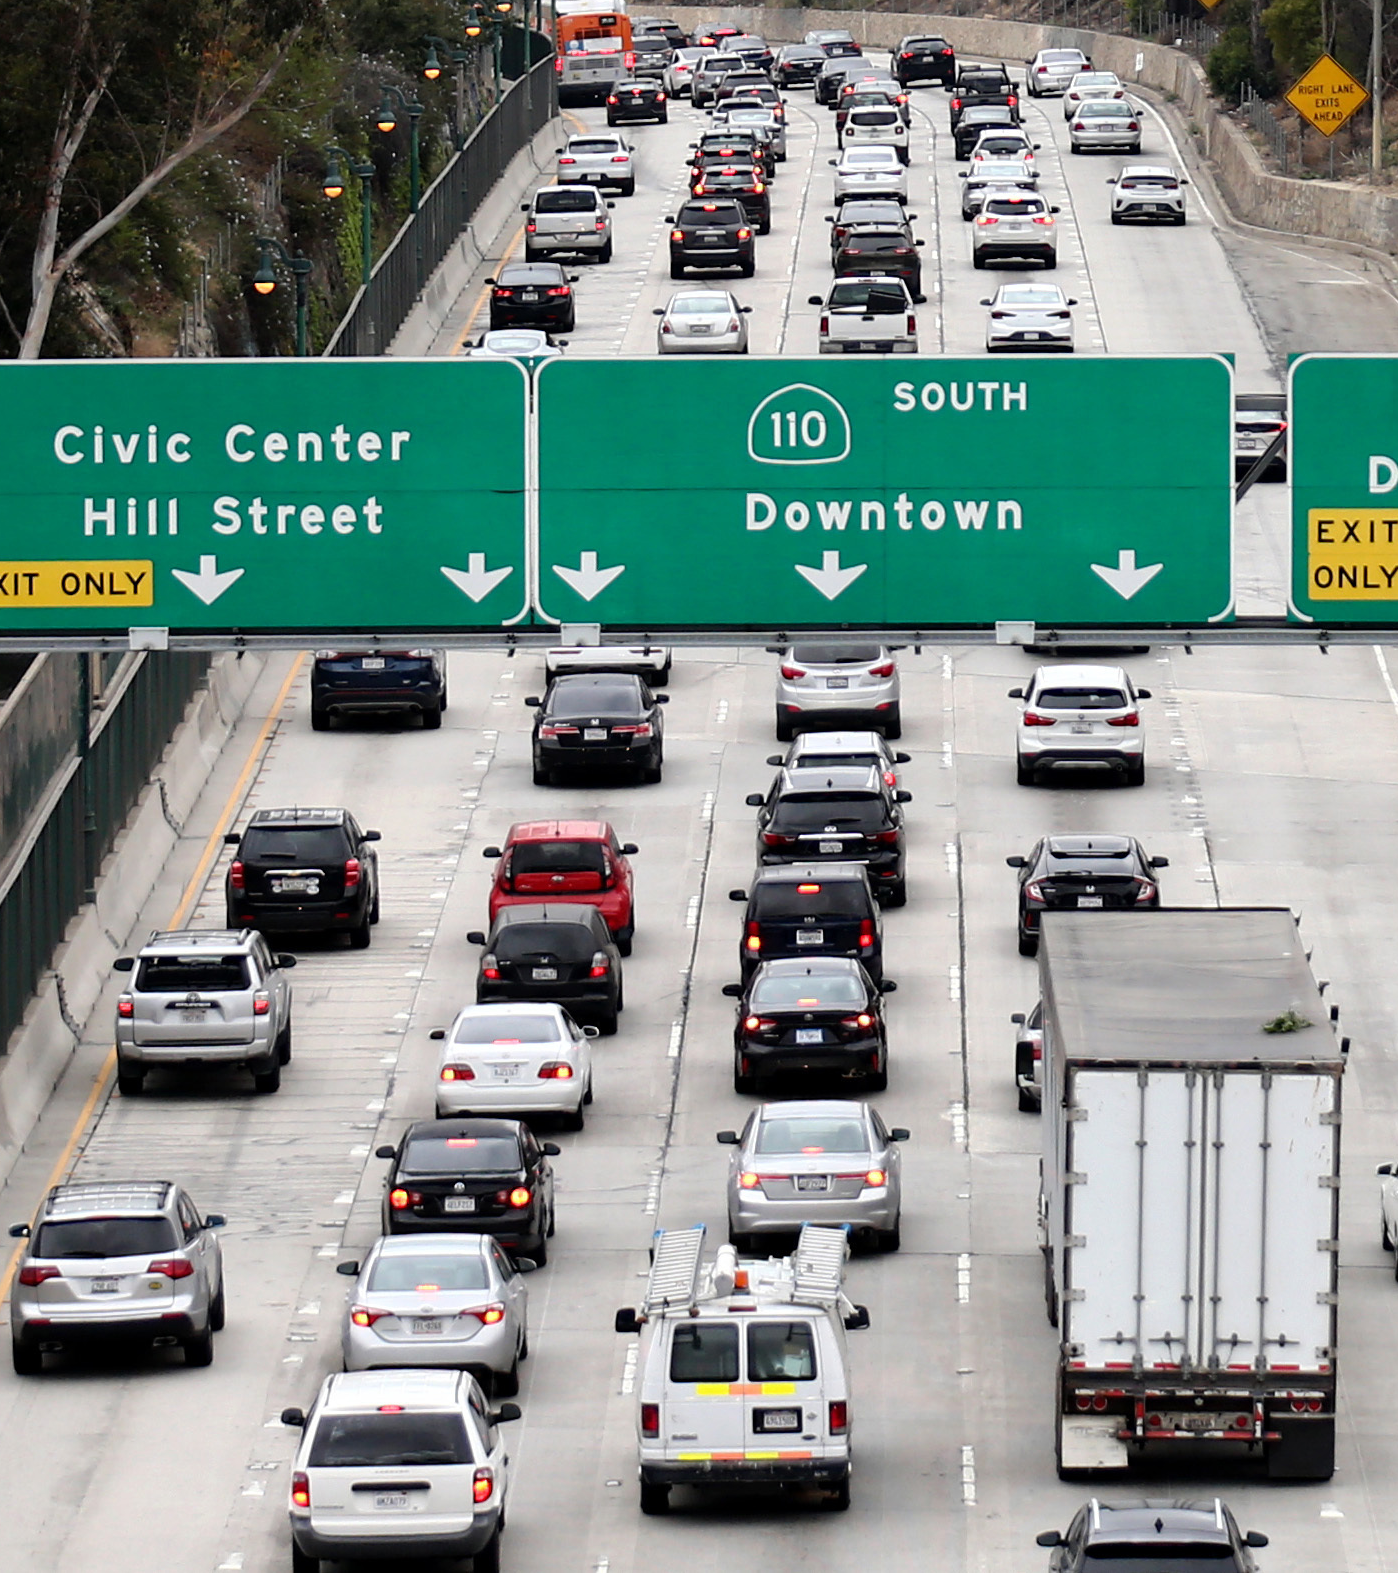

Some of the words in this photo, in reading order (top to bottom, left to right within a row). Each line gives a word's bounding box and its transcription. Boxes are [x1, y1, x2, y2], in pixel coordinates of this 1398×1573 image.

[1298, 85, 1324, 94] RIGHT
[1331, 84, 1355, 94] LANE
[1315, 98, 1339, 108] EXITS
[1314, 111, 1343, 121] AHEAD
[894, 382, 1026, 411] SOUTH
[771, 411, 826, 447] 110
[55, 425, 190, 464] Civic
[226, 425, 410, 462] Center
[85, 498, 177, 535] Hill
[212, 497, 382, 534] Street
[747, 493, 1021, 531] Downtown
[1318, 520, 1398, 543] EXIT
[62, 573, 145, 595] ONLY
[1315, 566, 1398, 588] ONLY
